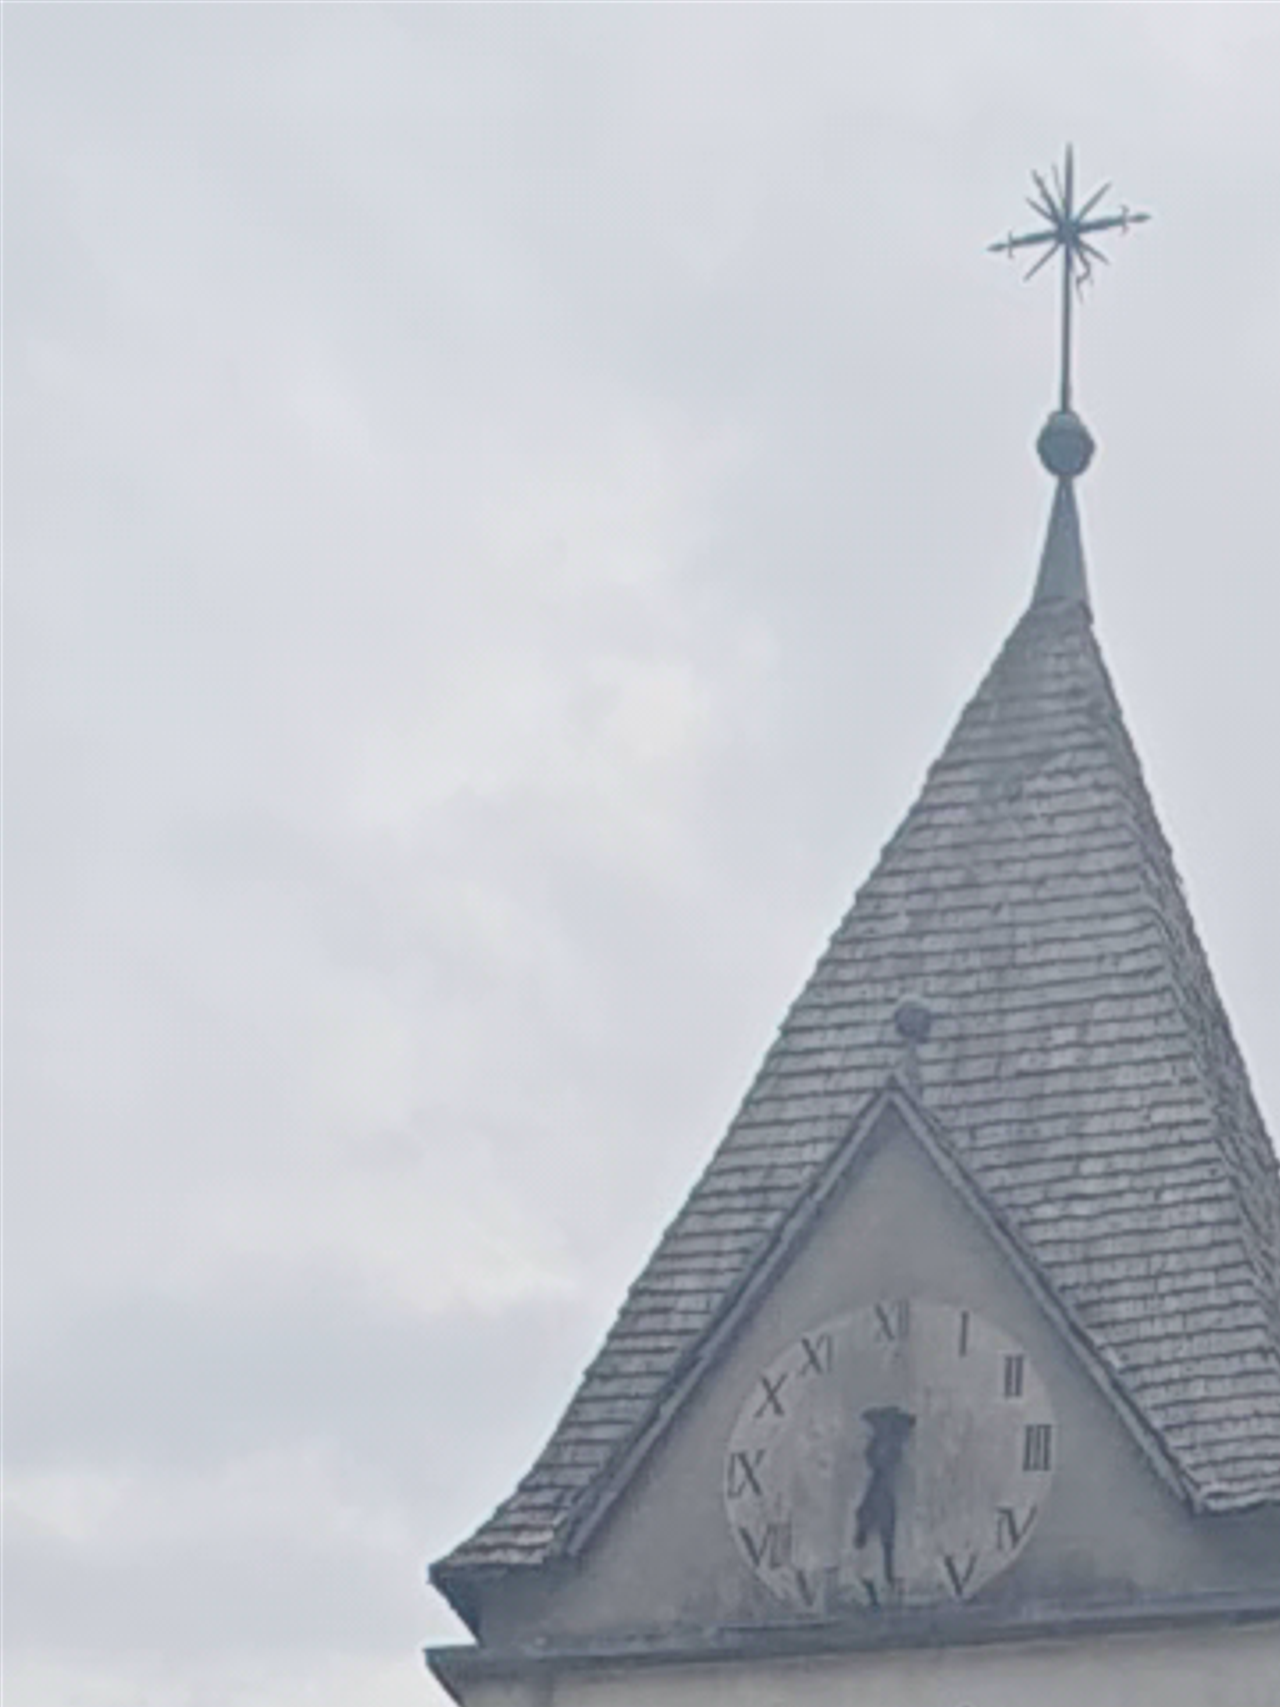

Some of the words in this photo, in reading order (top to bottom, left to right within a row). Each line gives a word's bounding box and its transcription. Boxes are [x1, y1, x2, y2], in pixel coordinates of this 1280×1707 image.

[959, 1310, 970, 1357] I
[753, 1370, 788, 1419] X
[1003, 1353, 1025, 1399] II
[1021, 1423, 1053, 1473] III
[726, 1448, 766, 1499] IX
